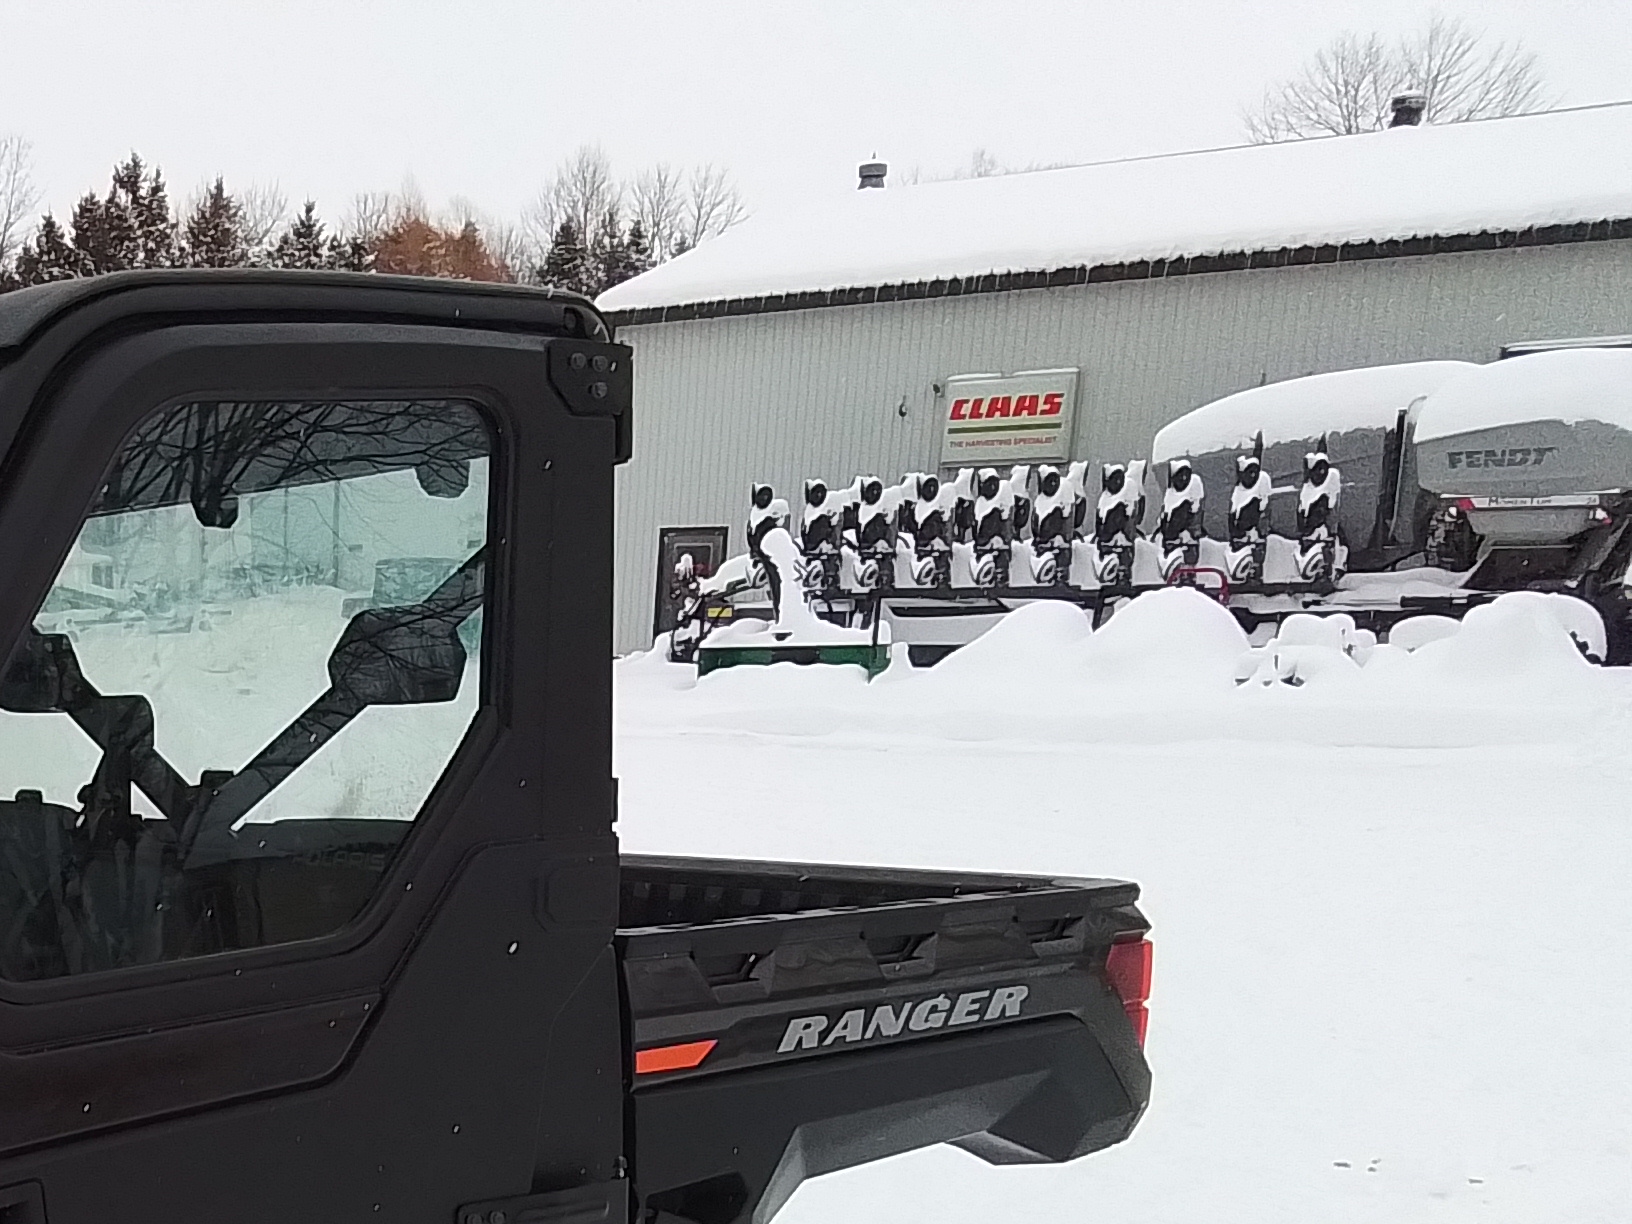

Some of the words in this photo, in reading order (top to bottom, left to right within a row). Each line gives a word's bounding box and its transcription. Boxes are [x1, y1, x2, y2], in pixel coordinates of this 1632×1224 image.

[949, 392, 1065, 420] CLAAS
[1447, 446, 1559, 469] FENDT
[776, 984, 1029, 1053] RANGER
